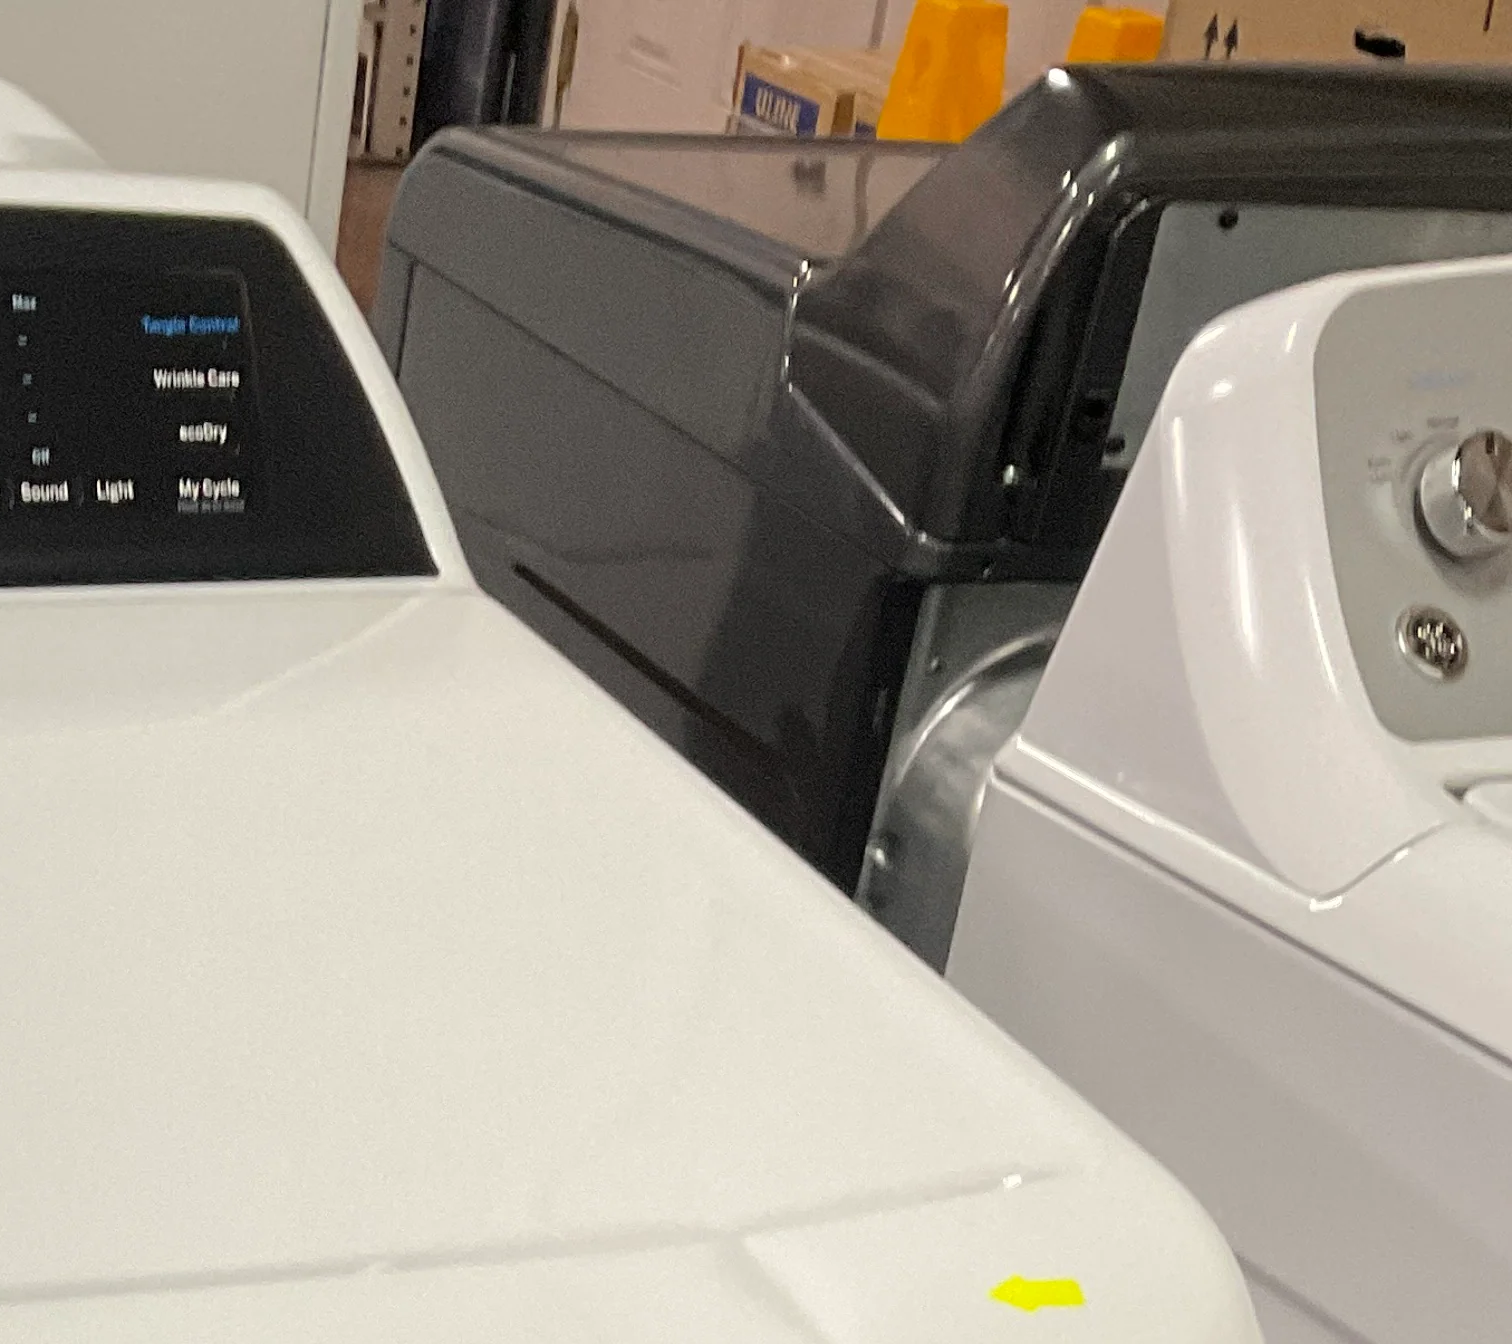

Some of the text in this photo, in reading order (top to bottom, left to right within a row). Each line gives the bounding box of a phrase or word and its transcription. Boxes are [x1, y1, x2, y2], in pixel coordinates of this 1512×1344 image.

[153, 367, 240, 389] Wrinkle Care
[21, 480, 69, 503] Sound
[96, 479, 135, 504] Light
[178, 477, 241, 502] My Cycle
